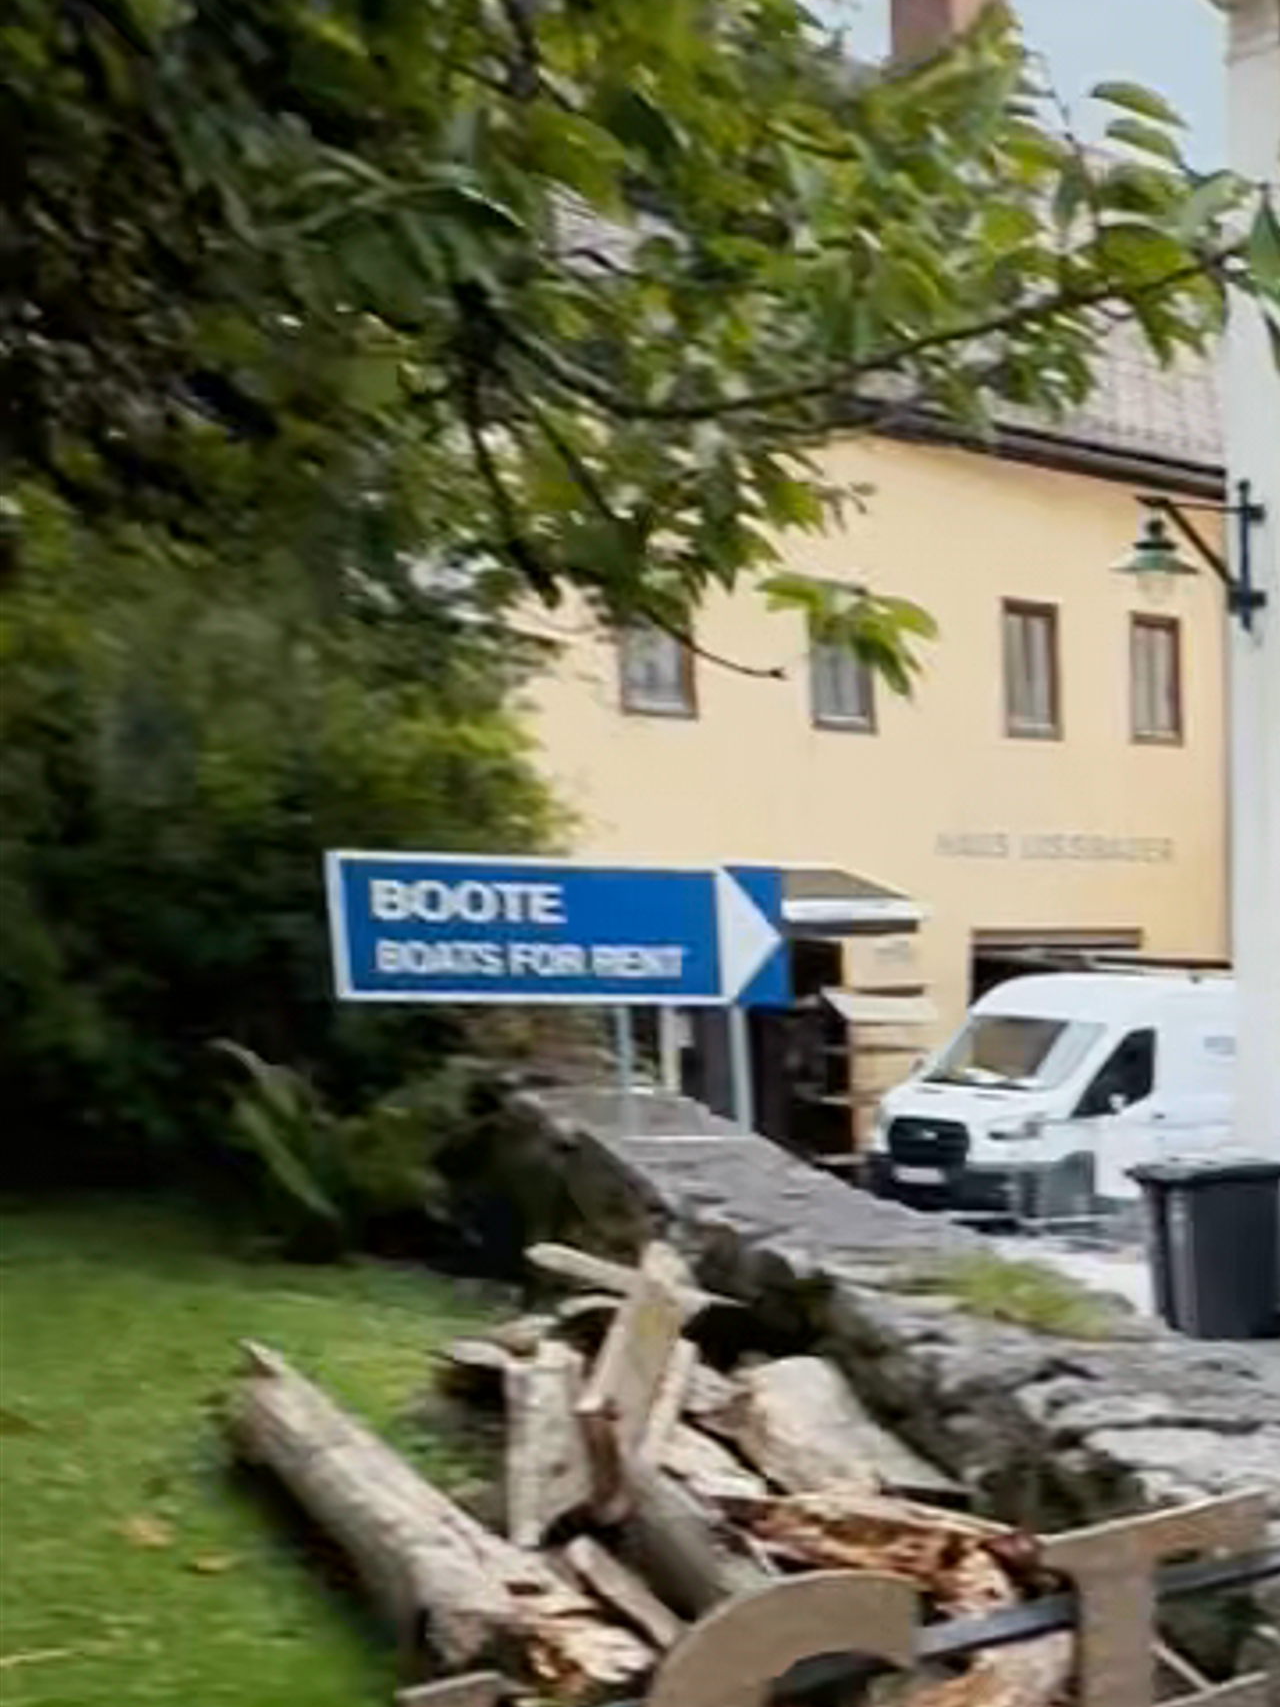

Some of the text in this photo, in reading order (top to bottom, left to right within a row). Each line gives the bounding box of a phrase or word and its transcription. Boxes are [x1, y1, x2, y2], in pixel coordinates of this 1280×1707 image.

[368, 878, 568, 924] BOOTE
[375, 939, 683, 979] BOATS FOR RENT
